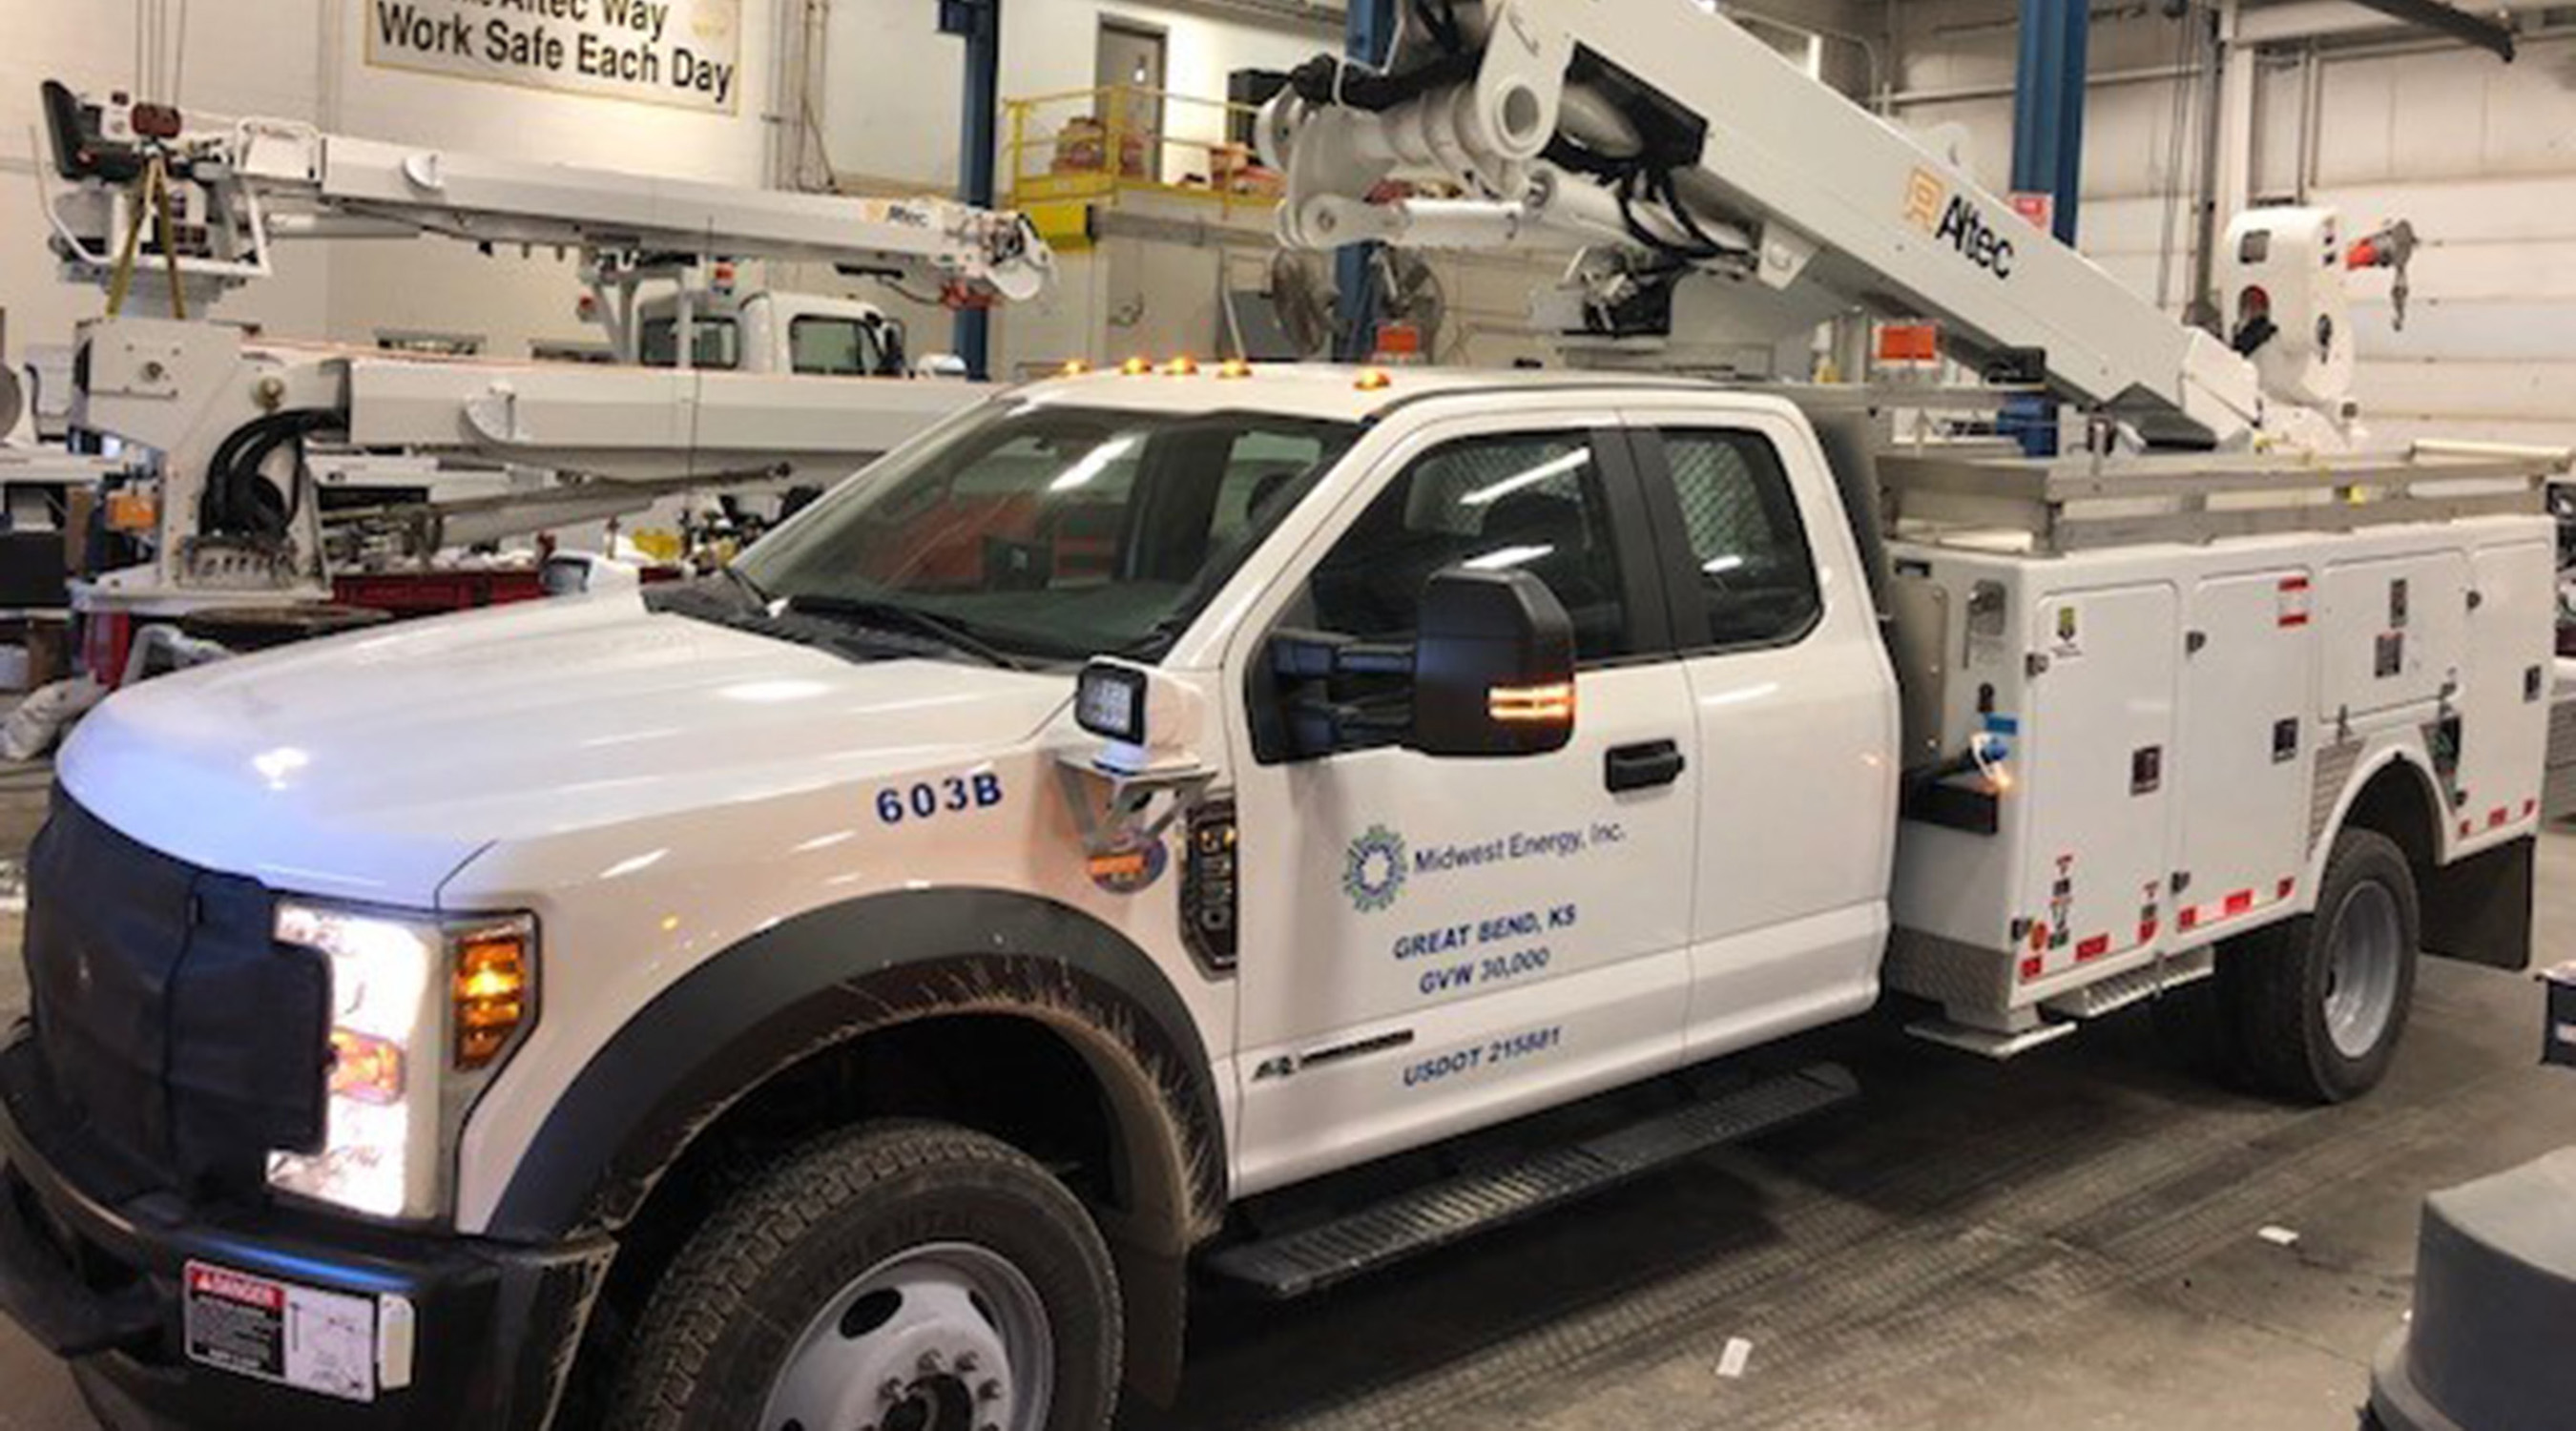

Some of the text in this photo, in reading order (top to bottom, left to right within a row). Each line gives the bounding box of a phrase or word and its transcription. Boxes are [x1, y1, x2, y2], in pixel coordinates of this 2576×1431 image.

[501, 0, 670, 43] tec Way
[378, 2, 735, 104] Work Safe Each Day
[1934, 195, 2014, 280] Altec
[875, 771, 1003, 824] 603B
[1414, 837, 1505, 875] Midwest
[1590, 821, 1627, 845] Inc.
[1393, 903, 1576, 961] GREAT BEND, KS
[1419, 945, 1551, 995] GVW 30,000
[1402, 1045, 1484, 1087] USDOT
